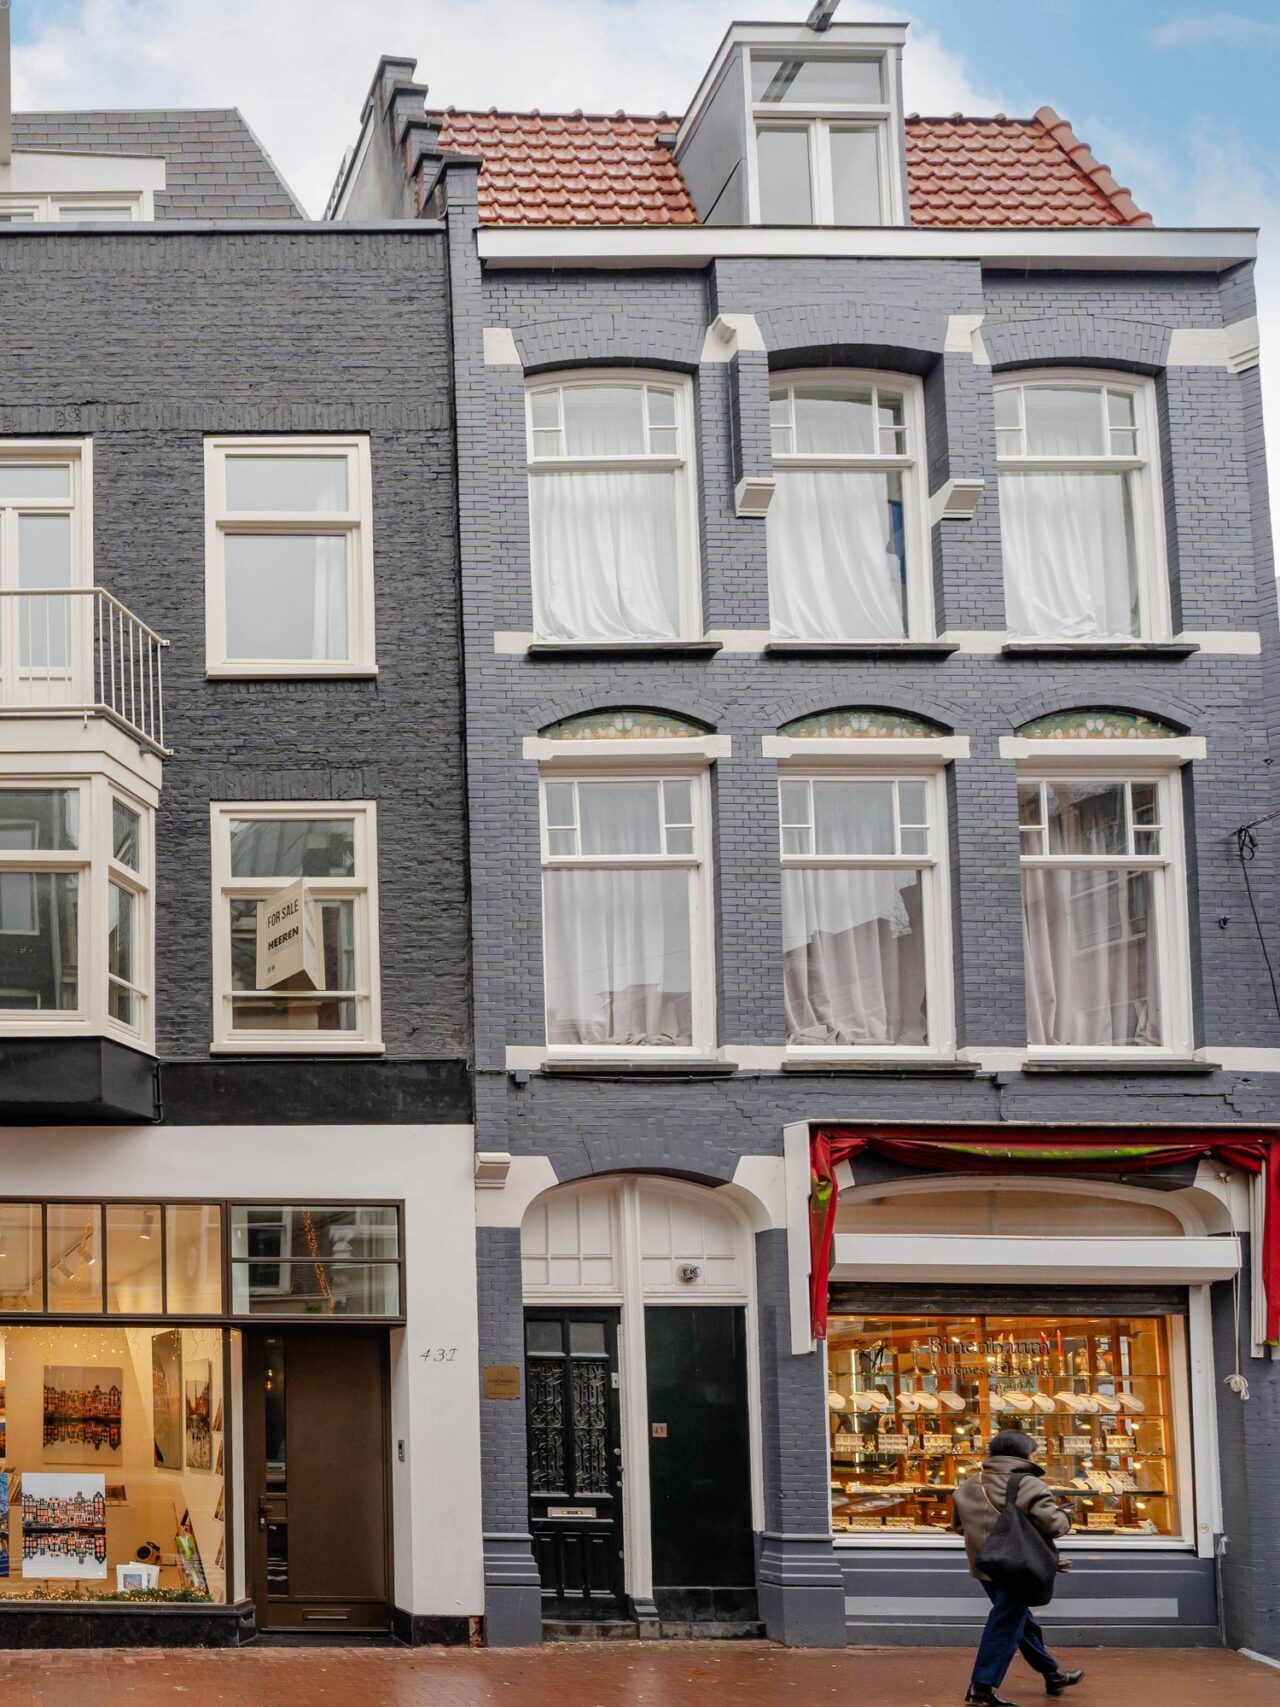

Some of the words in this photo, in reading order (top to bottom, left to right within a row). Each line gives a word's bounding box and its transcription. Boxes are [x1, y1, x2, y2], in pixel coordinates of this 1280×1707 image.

[267, 910, 281, 929] FOR
[281, 898, 299, 921] SALE
[267, 925, 299, 951] HEEREN
[930, 1362, 986, 1378] Antiques
